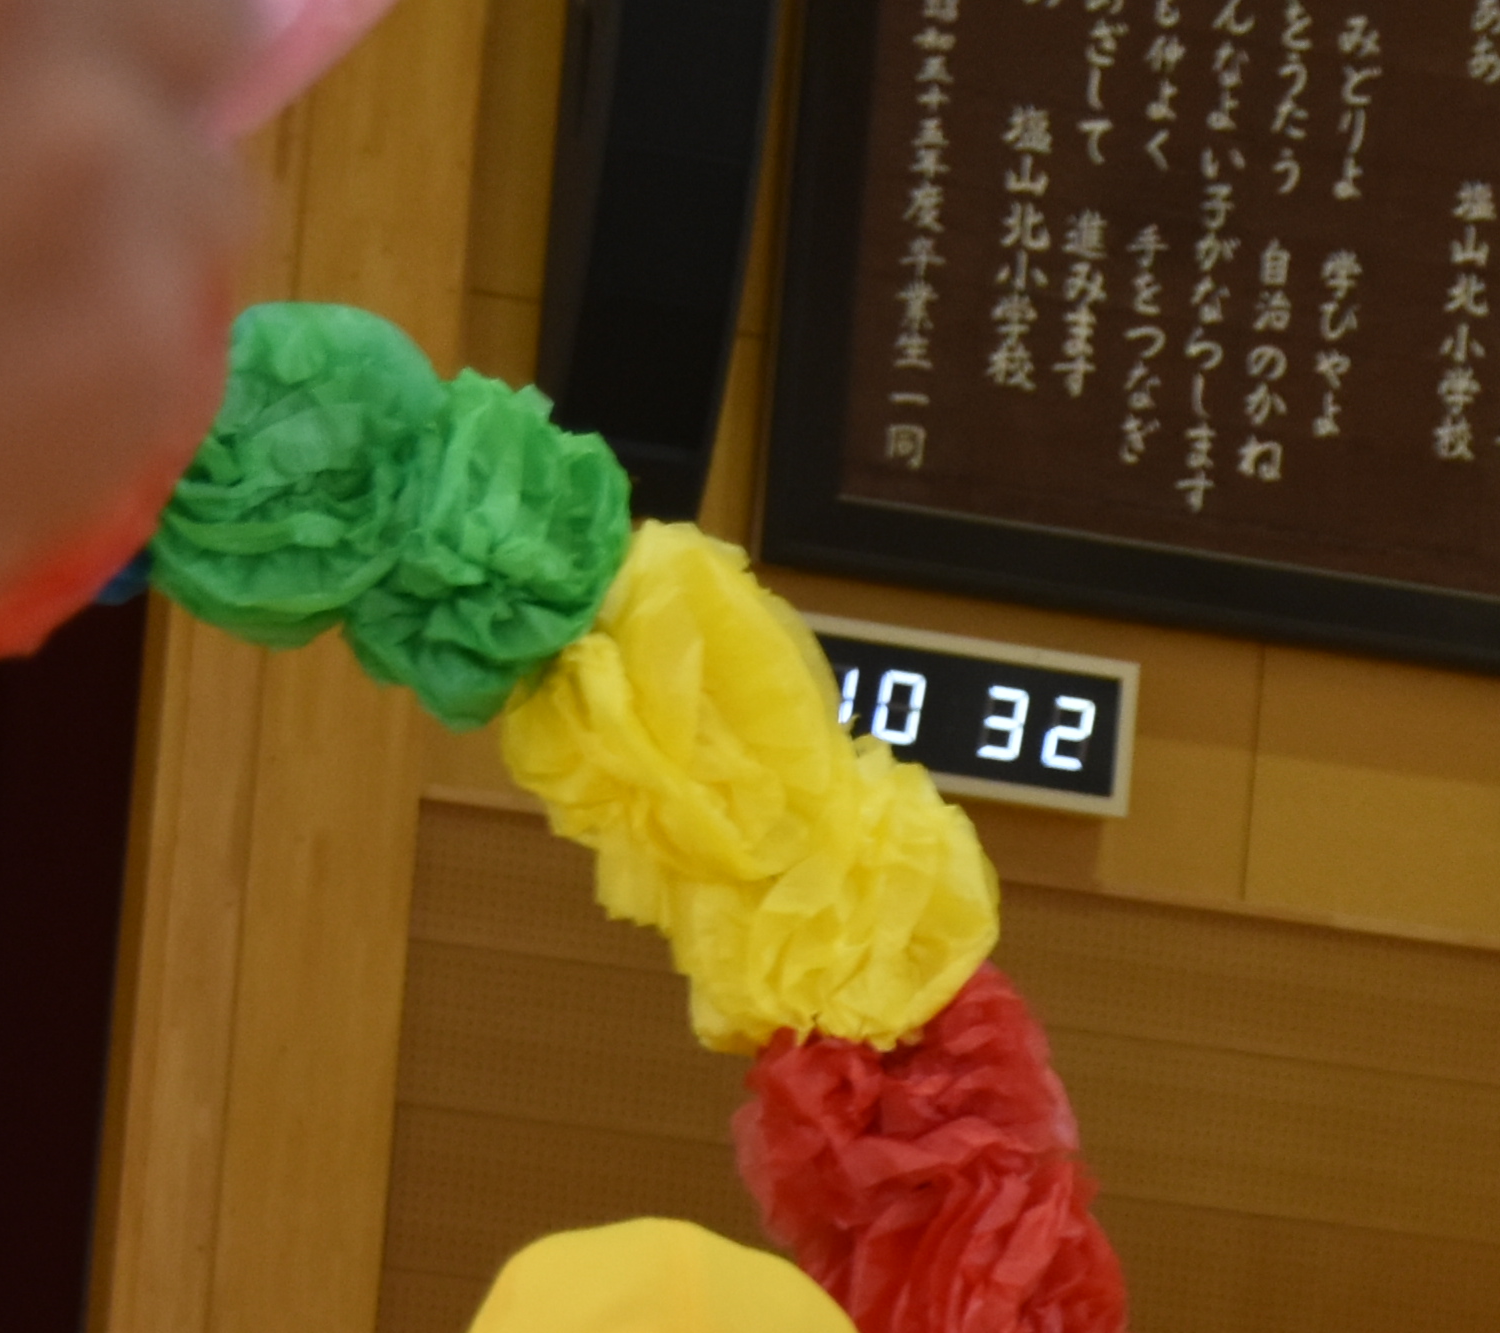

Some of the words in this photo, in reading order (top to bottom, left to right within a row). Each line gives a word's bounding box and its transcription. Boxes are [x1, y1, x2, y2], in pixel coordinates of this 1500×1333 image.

[1078, 0, 1128, 163] ざして
[1334, 16, 1381, 199] みどりよ
[1054, 210, 1106, 396] 進みます
[1122, 225, 1166, 463] 手をつなぎ
[1238, 240, 1290, 480] 自治のかね
[1313, 251, 1362, 436] 学びやよ
[838, 668, 927, 745] 10
[976, 685, 1097, 772] 32
